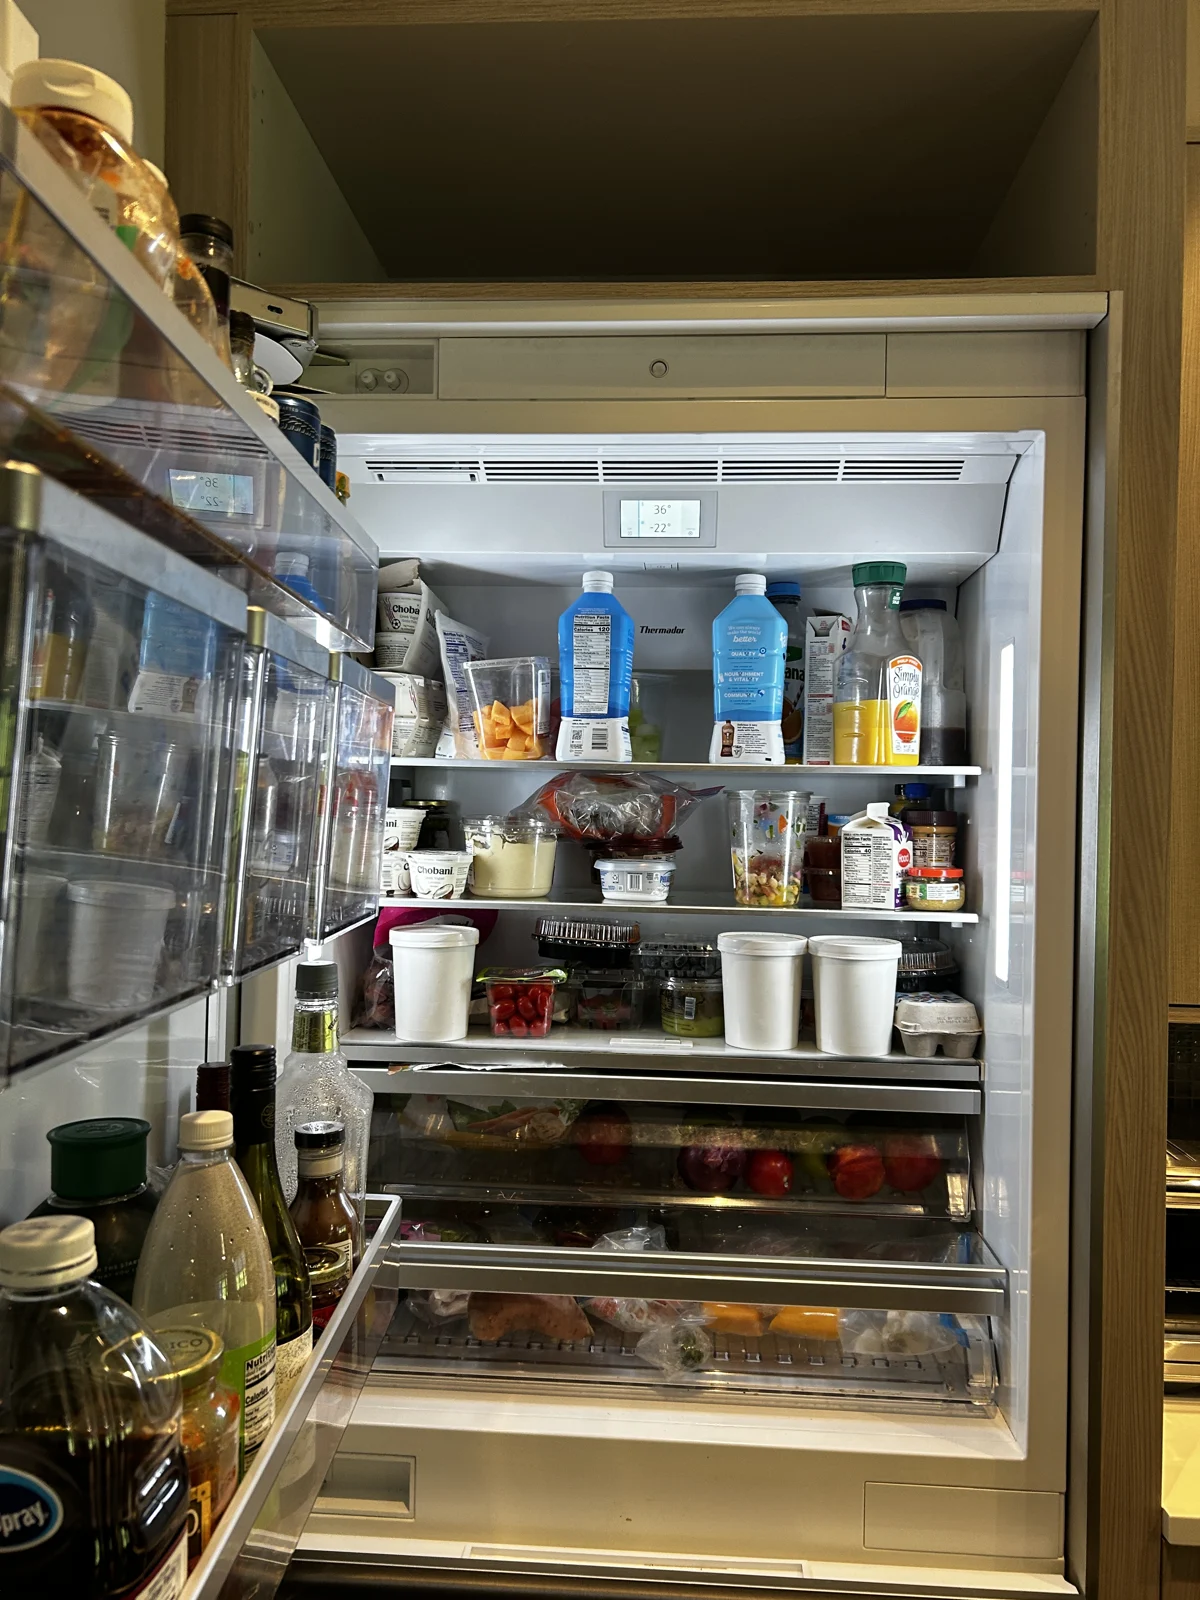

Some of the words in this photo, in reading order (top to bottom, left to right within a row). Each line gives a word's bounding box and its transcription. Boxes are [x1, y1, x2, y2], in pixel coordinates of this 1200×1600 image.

[392, 604, 420, 615] Choba
[639, 625, 686, 634] Thermador
[893, 666, 920, 687] Simply
[892, 683, 920, 700] Orange
[417, 865, 454, 875] Chobani
[0, 1500, 47, 1538] pray
